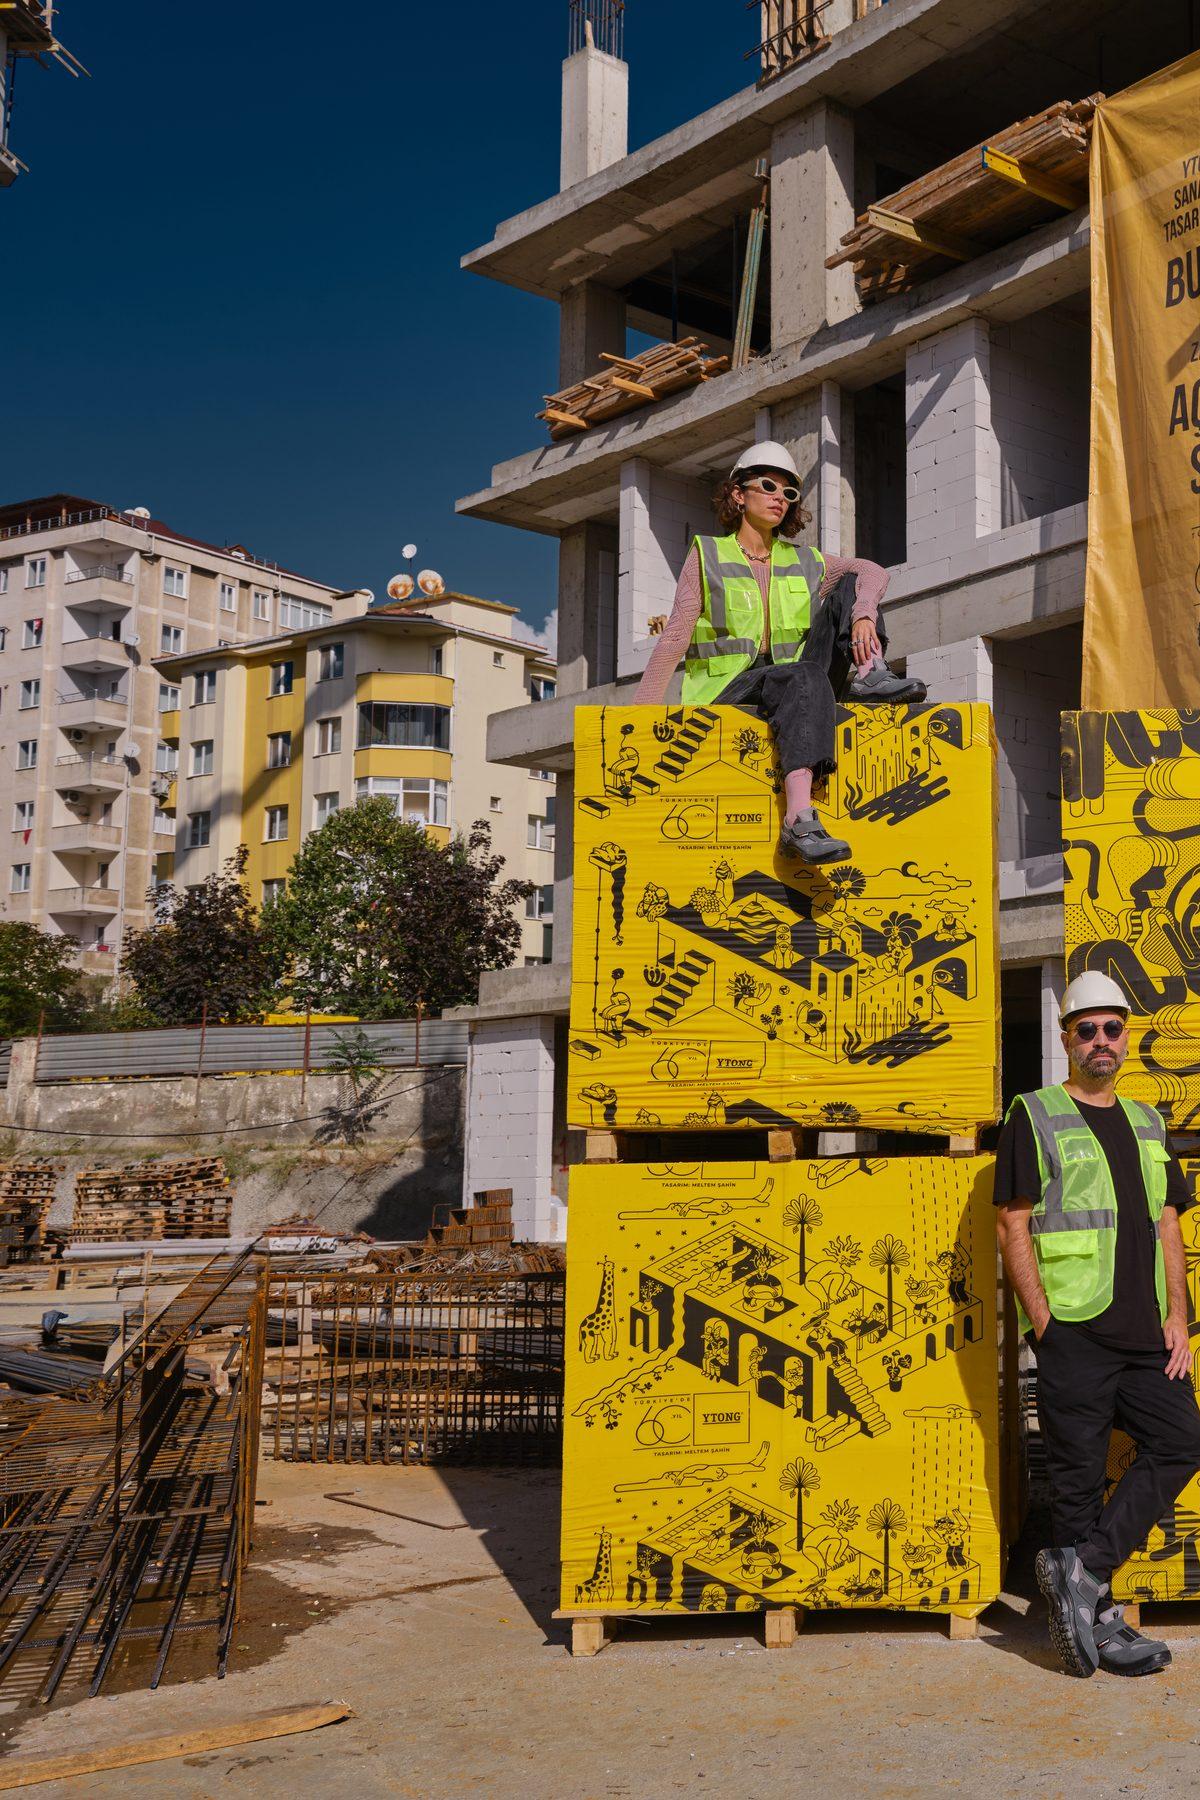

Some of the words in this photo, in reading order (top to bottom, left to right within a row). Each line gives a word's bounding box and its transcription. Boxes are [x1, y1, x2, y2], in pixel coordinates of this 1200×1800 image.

[725, 813, 763, 822] YTONG
[717, 1058, 753, 1067] YTONG
[702, 1412, 741, 1422] YTONG
